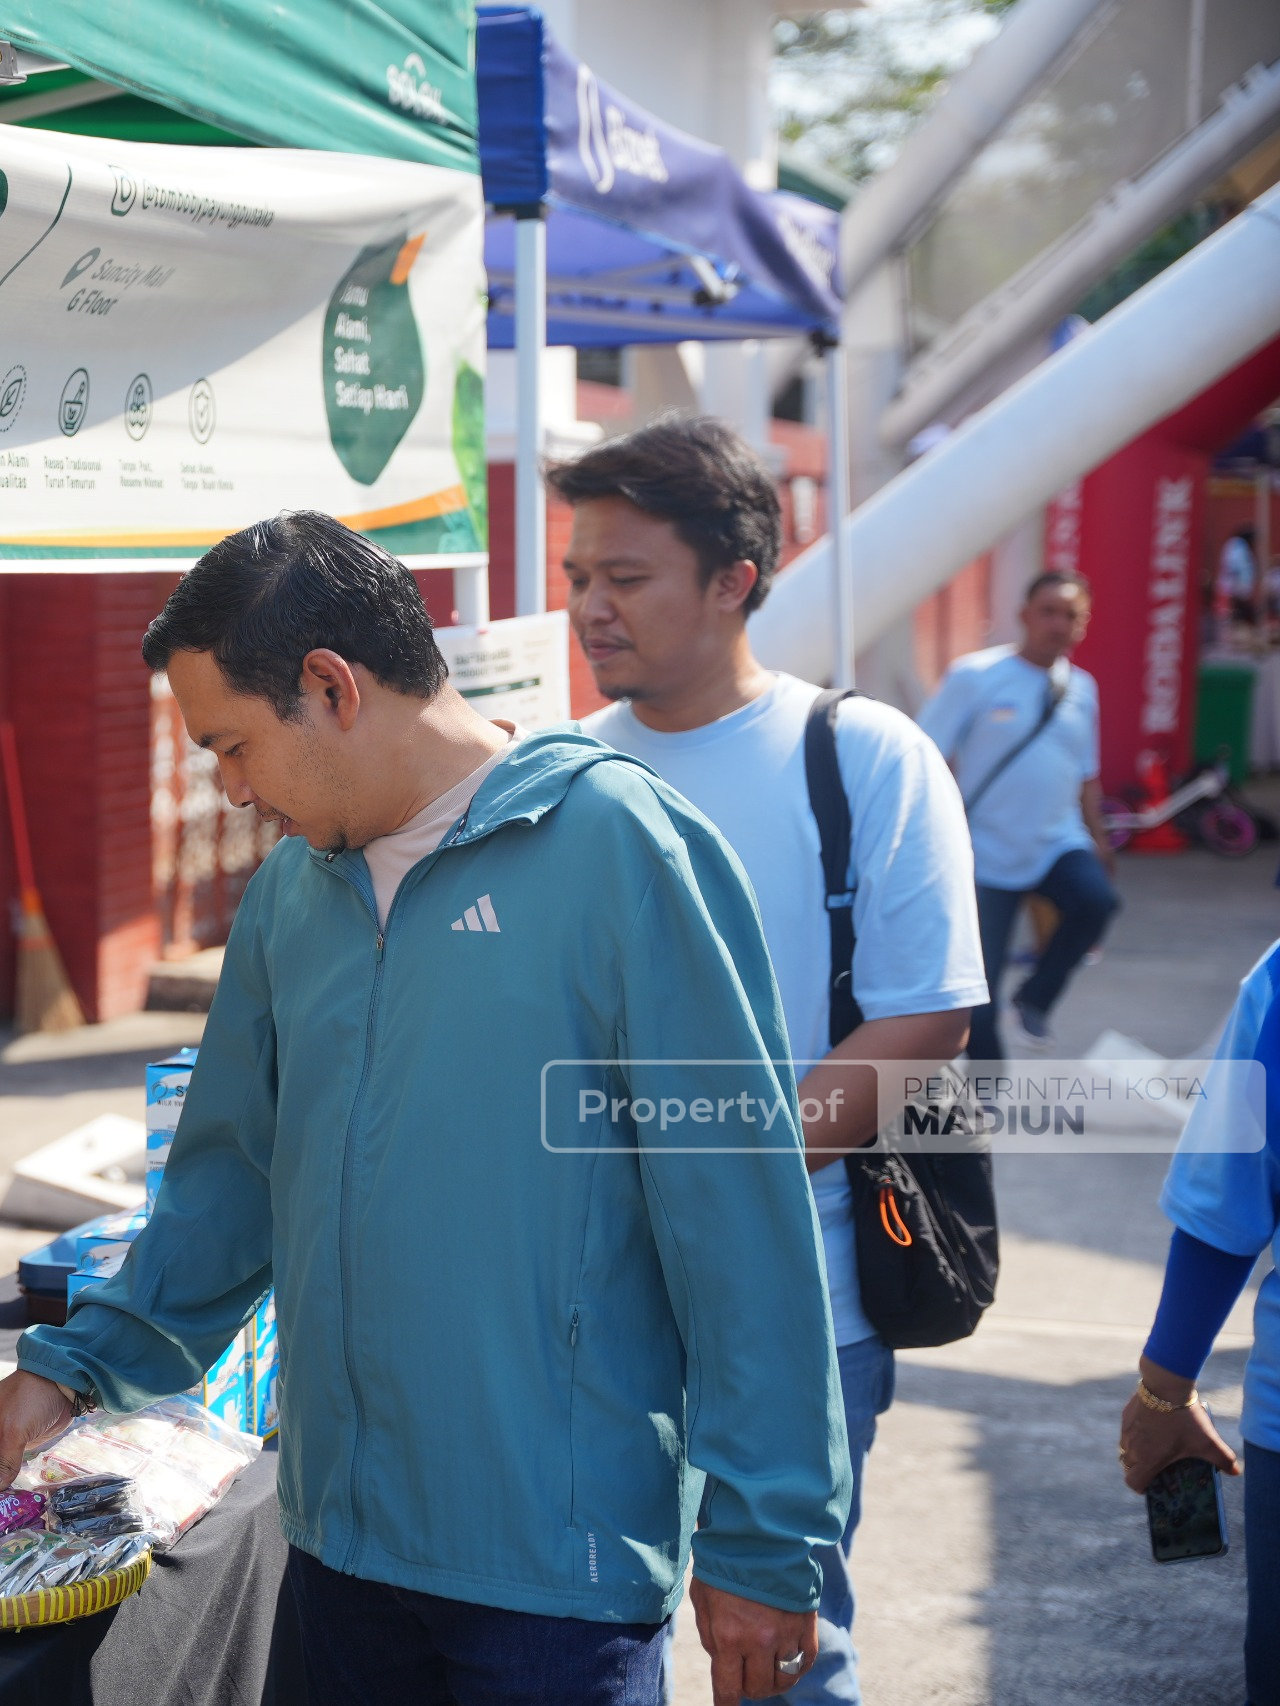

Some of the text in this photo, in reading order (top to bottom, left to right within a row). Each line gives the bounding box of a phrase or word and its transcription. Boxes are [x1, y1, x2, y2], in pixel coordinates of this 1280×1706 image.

[91, 258, 175, 290] Suncity Mall
[66, 288, 118, 316] G Floor
[334, 345, 371, 376] Sehat
[335, 379, 374, 416] Setiap
[7, 451, 30, 468] Alami
[587, 1532, 599, 1583] AEROREADY
